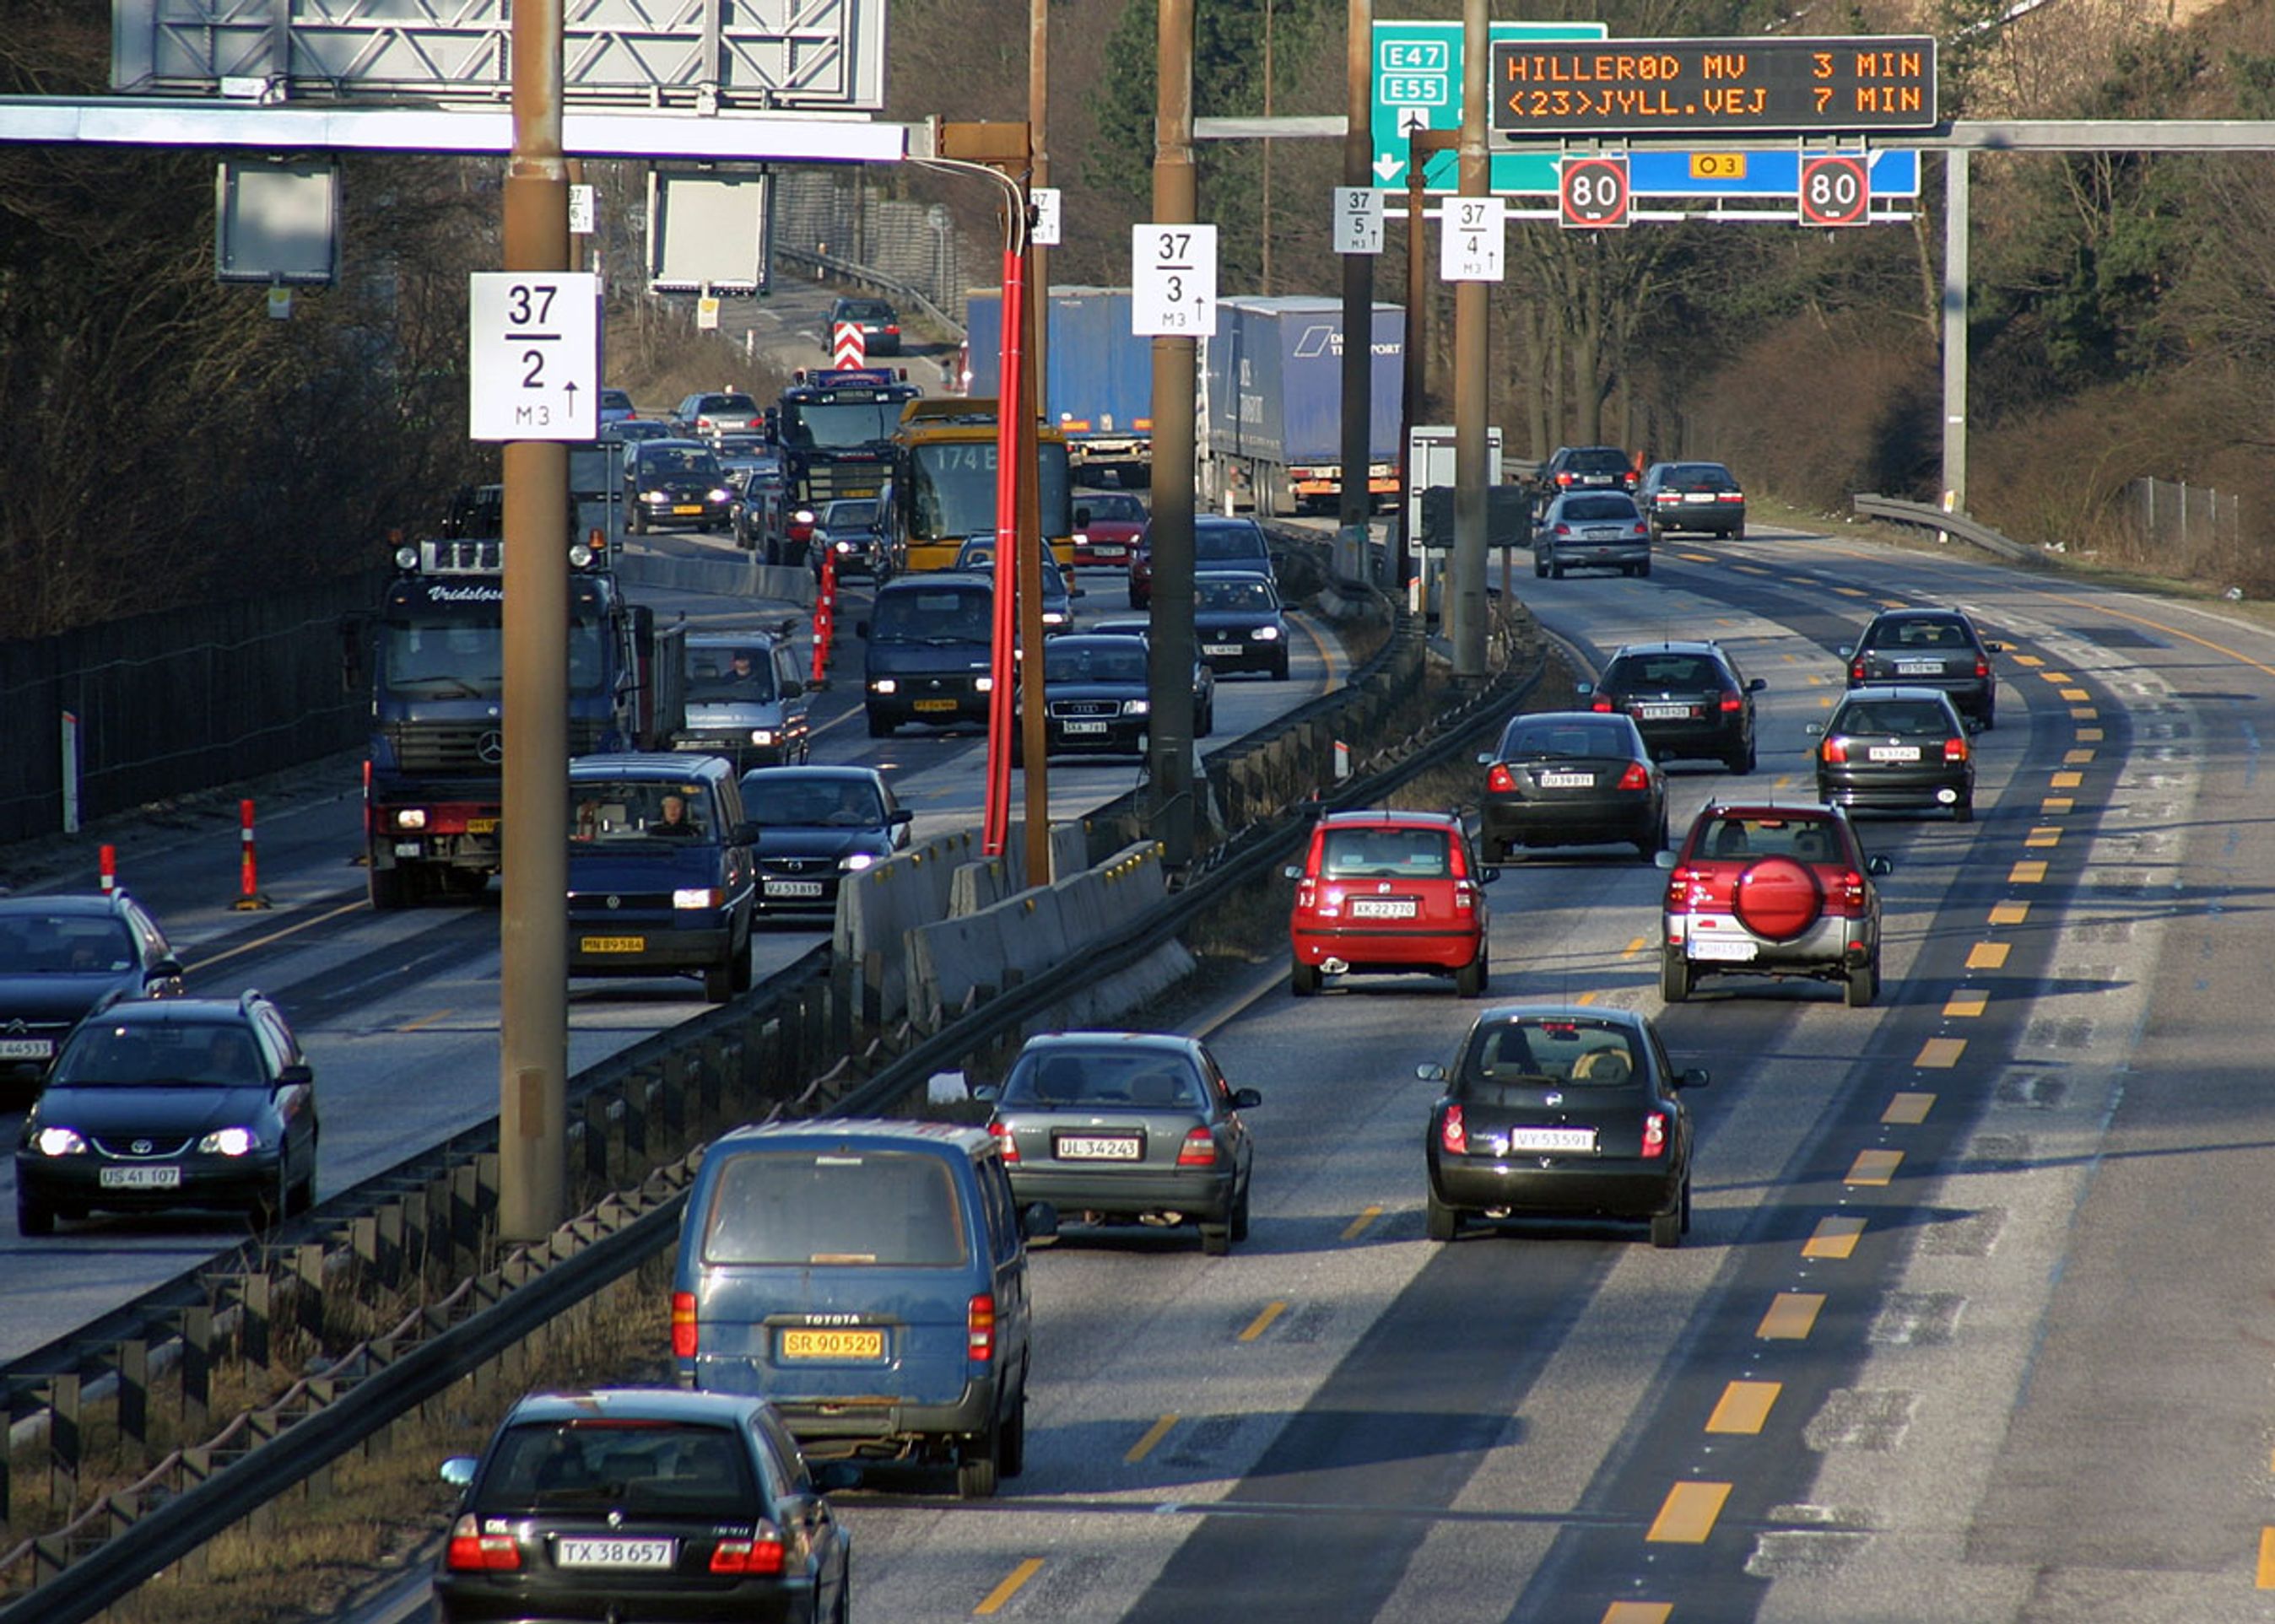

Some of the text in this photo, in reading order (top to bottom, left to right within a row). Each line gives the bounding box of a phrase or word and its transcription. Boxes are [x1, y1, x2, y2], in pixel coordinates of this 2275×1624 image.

[1390, 47, 1439, 66] E47
[1703, 54, 1747, 80] MV
[1813, 52, 1835, 78] 3
[1856, 52, 1921, 78] MIN
[1391, 79, 1437, 99] E55
[1813, 88, 1834, 113] 7
[1856, 87, 1921, 112] MIN
[1349, 192, 1370, 208] 37
[1573, 175, 1617, 206] 80
[1811, 174, 1856, 204] 80
[1354, 218, 1364, 234] 5
[1461, 204, 1485, 224] 37
[1159, 233, 1191, 259] 37
[1467, 235, 1478, 254] 4
[1167, 275, 1182, 302] 3
[509, 285, 558, 324] 37
[522, 349, 544, 388] 2
[805, 1314, 860, 1325] TOYOTA
